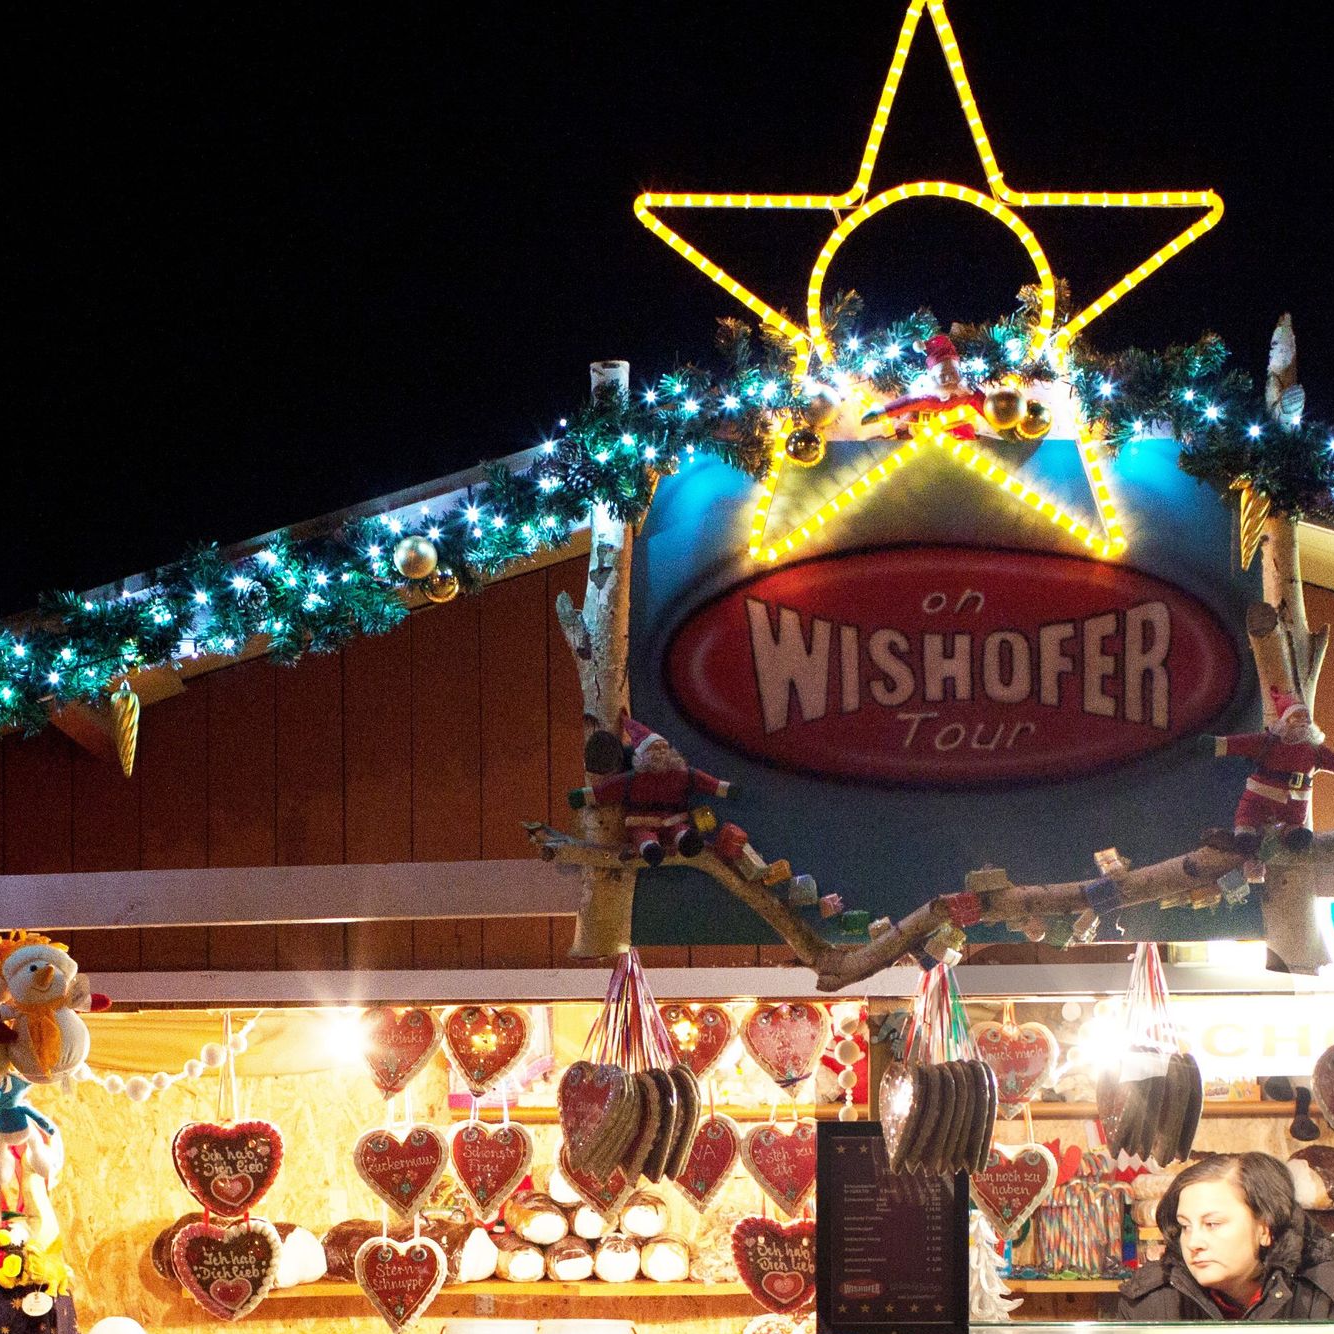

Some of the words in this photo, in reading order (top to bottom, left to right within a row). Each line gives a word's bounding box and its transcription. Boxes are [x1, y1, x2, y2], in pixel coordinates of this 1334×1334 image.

[922, 590, 986, 614] on
[745, 597, 1171, 735] WISHOFER
[897, 711, 1037, 752] Tour
[200, 1149, 224, 1163] Ich
[227, 1147, 255, 1160] hab
[367, 1154, 437, 1174] Zuckermaus
[203, 1162, 233, 1177] Dich
[236, 1158, 264, 1174] lieb
[467, 1158, 501, 1173] Frau
[994, 1168, 1022, 1183] noch
[1023, 1173, 1042, 1184] zu
[990, 1183, 1031, 1196] haben
[202, 1247, 228, 1266] Ich
[230, 1250, 257, 1265] hab
[756, 1243, 783, 1258] Ich
[199, 1265, 231, 1280] Dich
[230, 1262, 260, 1278] lieb
[756, 1257, 788, 1273] Dich
